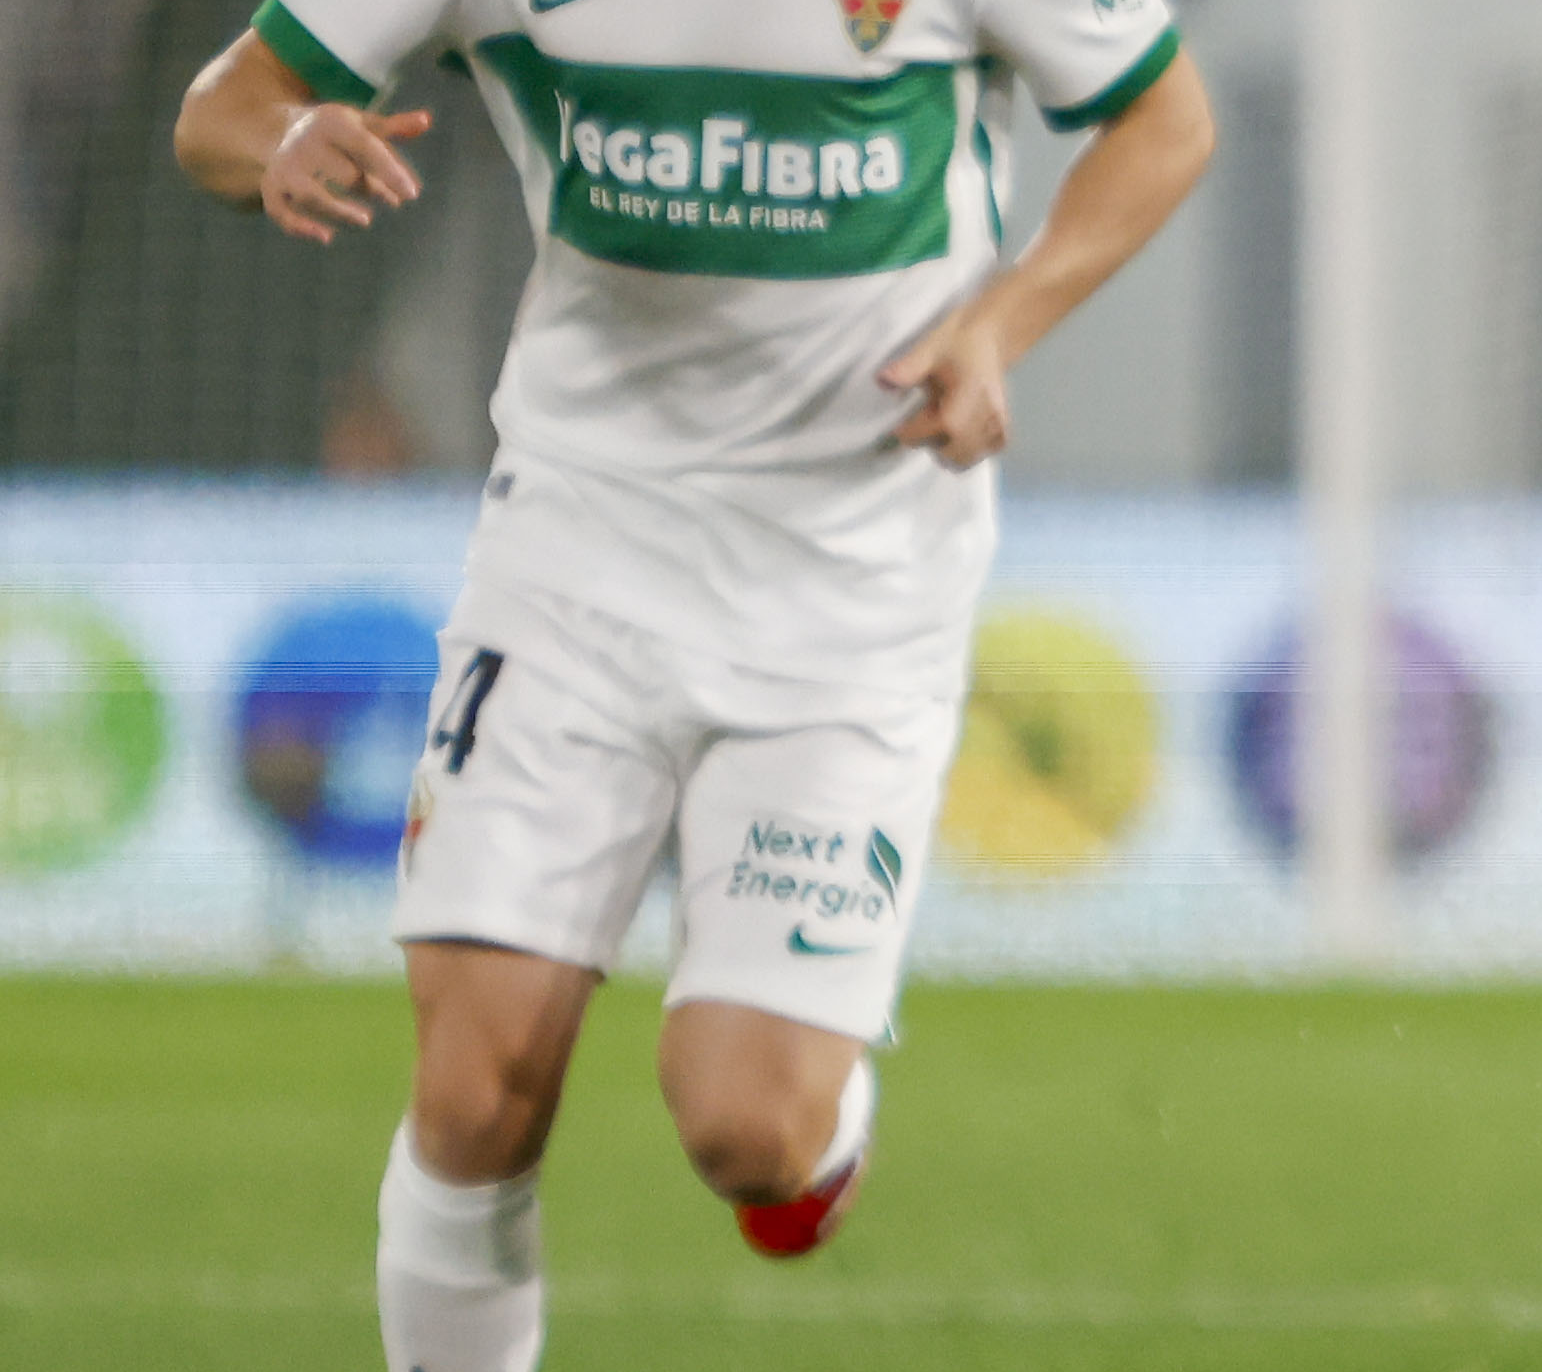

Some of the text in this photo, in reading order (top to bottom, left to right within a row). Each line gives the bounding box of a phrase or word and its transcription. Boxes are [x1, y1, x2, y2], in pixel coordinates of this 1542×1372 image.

[588, 186, 828, 232] EL REY DE LA FIBRA
[741, 820, 845, 863] Next
